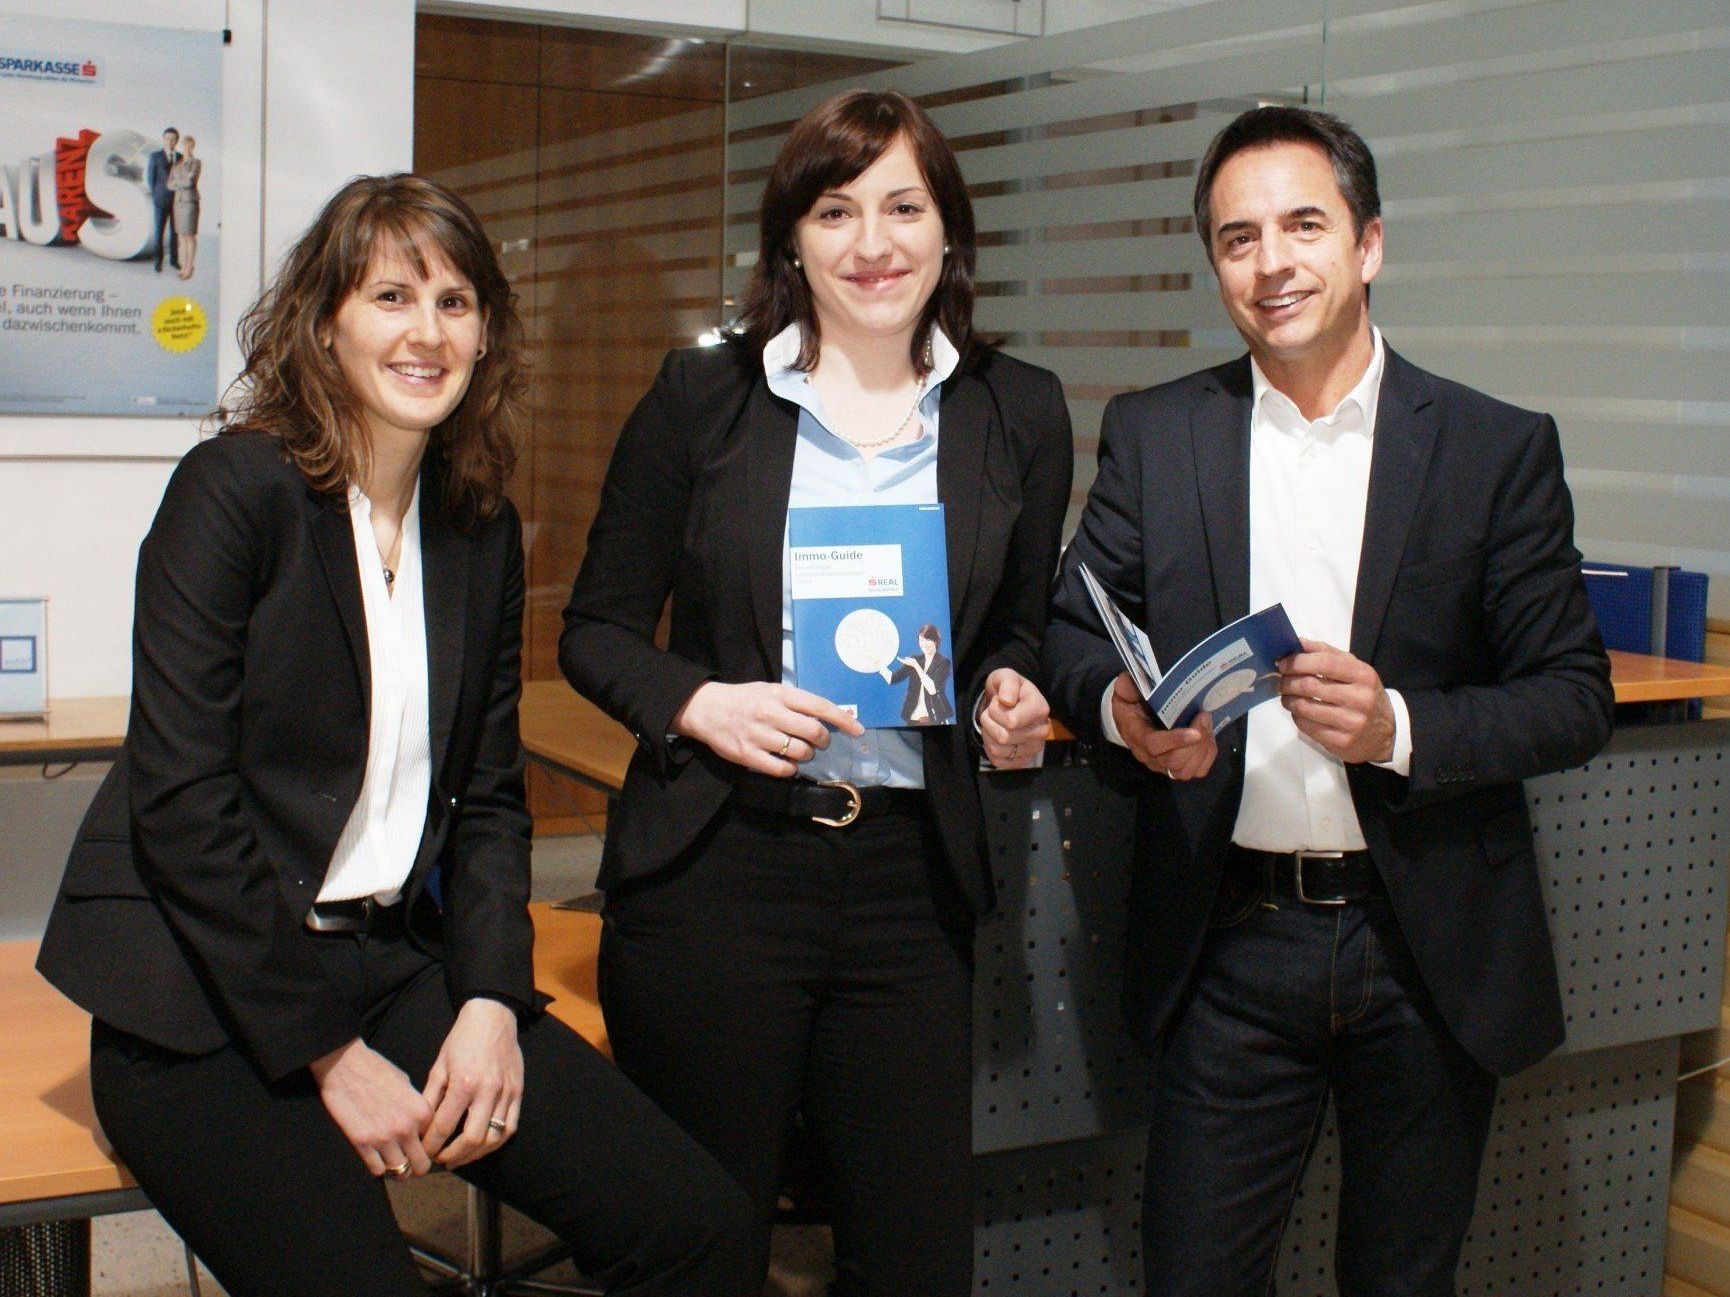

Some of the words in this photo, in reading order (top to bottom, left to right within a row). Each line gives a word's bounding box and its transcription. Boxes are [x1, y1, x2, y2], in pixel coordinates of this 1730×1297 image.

[0, 57, 80, 75] SPARKASSE
[12, 284, 104, 303] Finanzierung
[16, 302, 52, 315] auch
[58, 304, 96, 316] wenn
[101, 305, 142, 318] Ihnen
[3, 318, 141, 335] dazwischenkommt.
[794, 550, 863, 562] Immo-Guide
[878, 578, 899, 586] REAL
